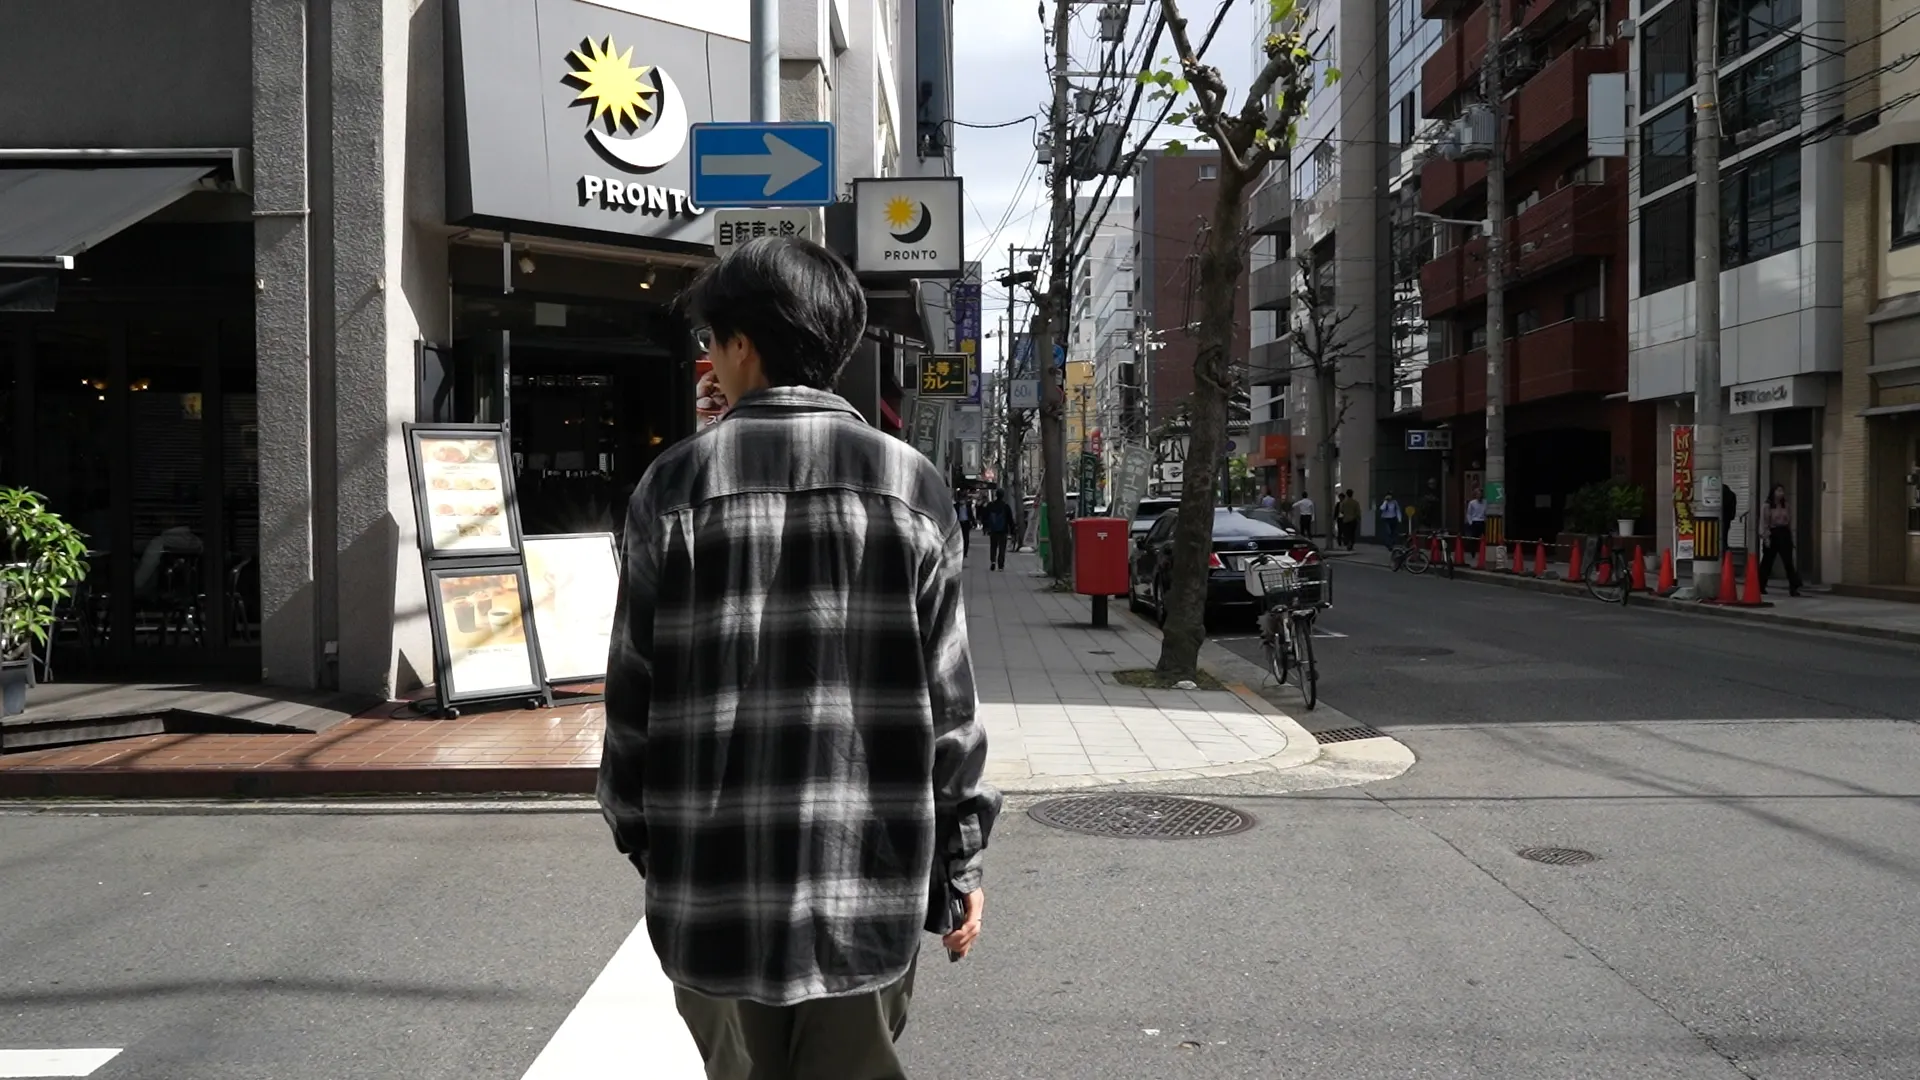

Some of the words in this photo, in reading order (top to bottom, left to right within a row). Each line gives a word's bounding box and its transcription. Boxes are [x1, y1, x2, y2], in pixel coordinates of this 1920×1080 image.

[884, 250, 937, 260] PRONTO
[923, 361, 950, 376] 上等
[923, 376, 963, 390] カレー
[1410, 434, 1422, 446] P
